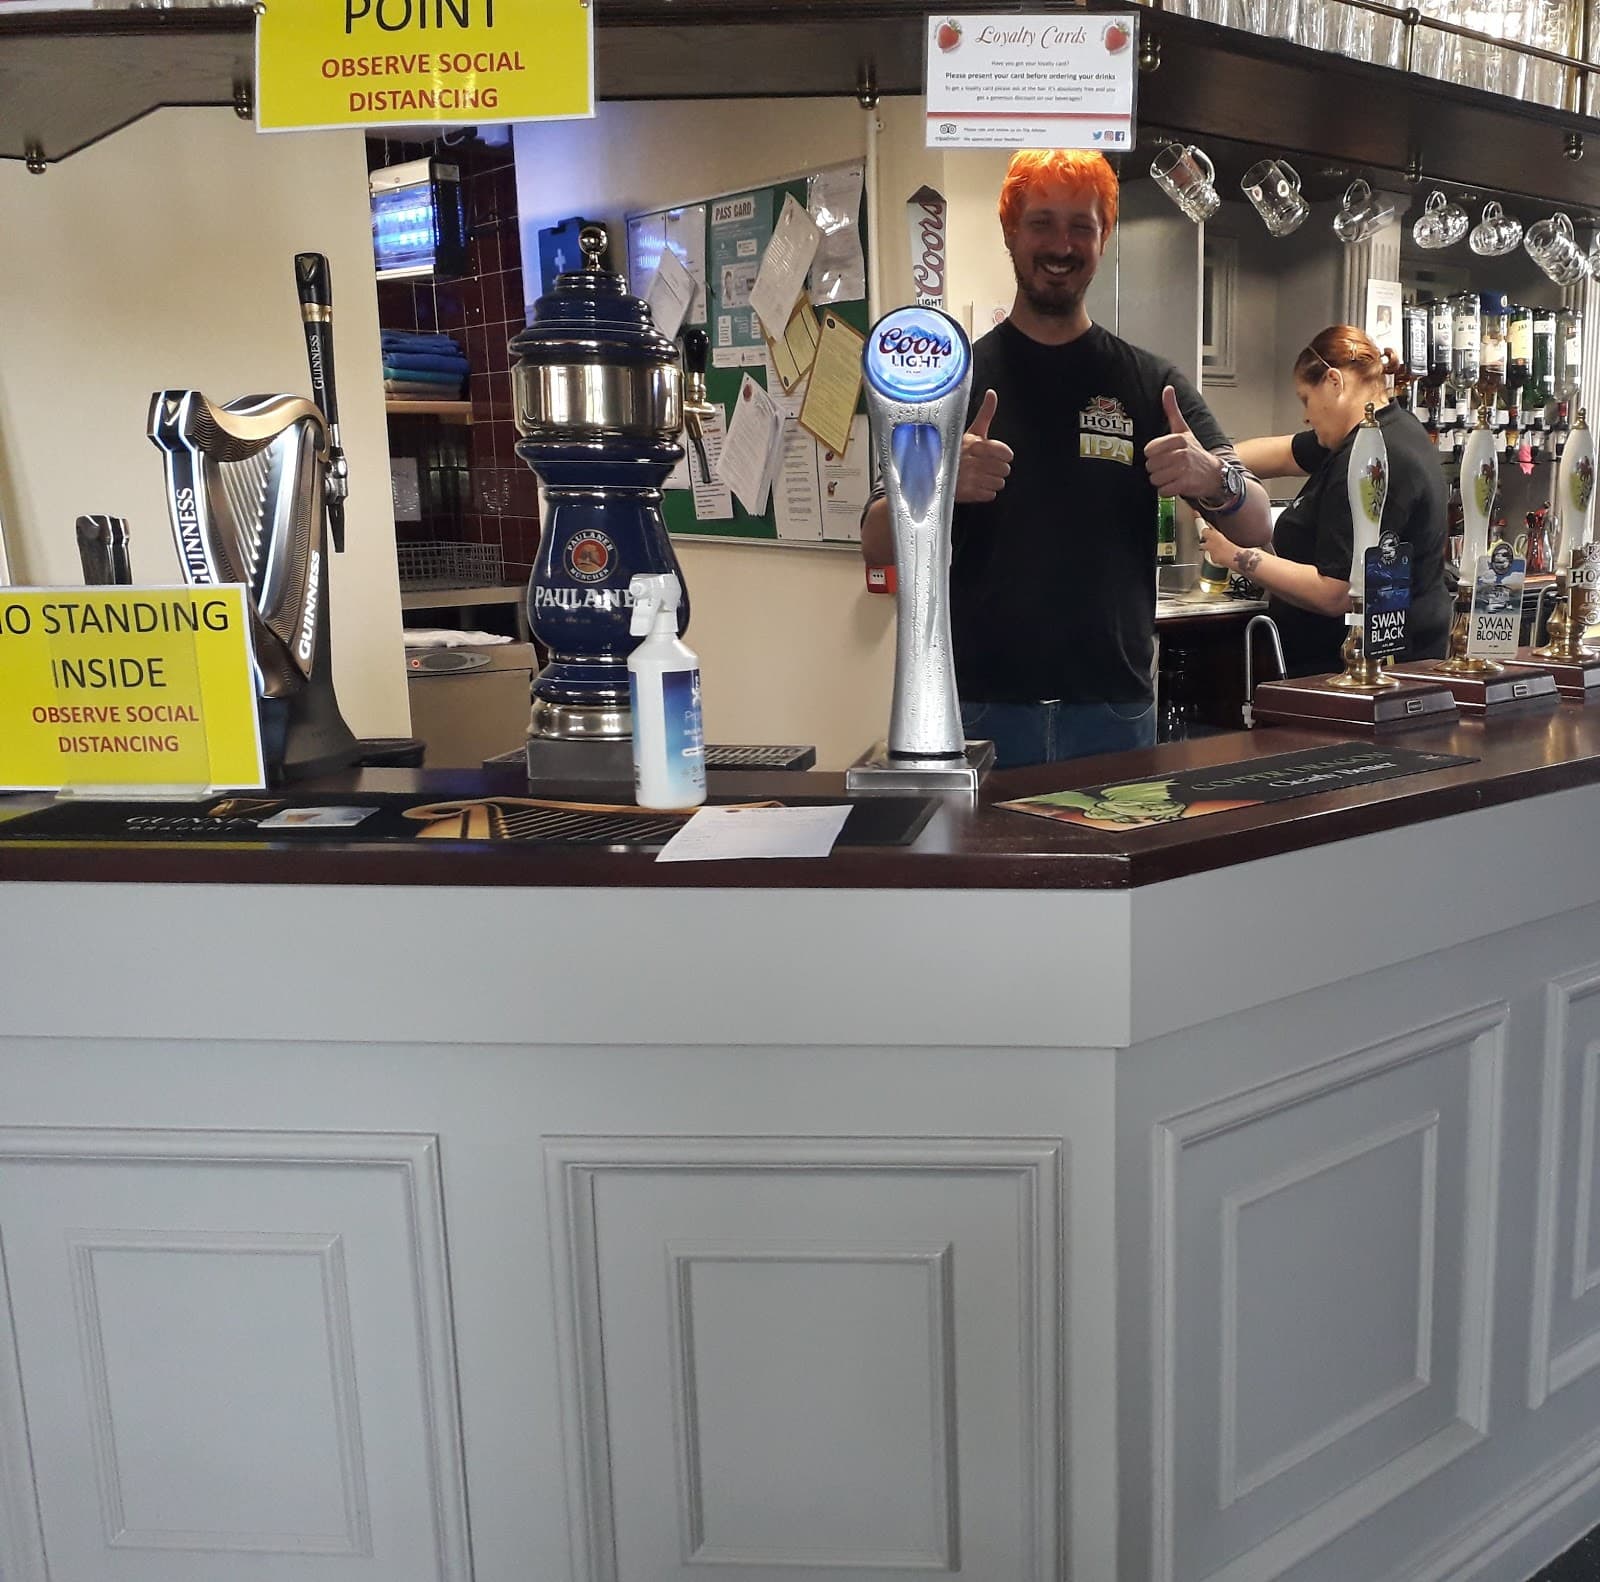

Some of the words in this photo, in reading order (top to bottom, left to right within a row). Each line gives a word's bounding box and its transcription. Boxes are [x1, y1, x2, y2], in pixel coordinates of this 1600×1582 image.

[344, 0, 494, 34] POINT
[974, 25, 1036, 47] Loyalty
[1040, 26, 1088, 49] Cards
[321, 53, 430, 79] OBSERVE
[438, 51, 526, 73] SOCIAL
[945, 72, 966, 80] Please
[968, 72, 992, 80] present
[1010, 72, 1025, 80] card
[1026, 72, 1048, 80] before
[1049, 73, 1077, 81] ordering
[349, 87, 498, 113] DISTANCING
[715, 205, 732, 221] PASS
[733, 201, 752, 217] CARD
[913, 200, 945, 297] Coors
[917, 298, 943, 307] LIGHT
[879, 327, 953, 355] Coors
[309, 334, 325, 390] GUINNESS
[892, 354, 942, 369] LIGHT
[1083, 415, 1131, 432] HOLT
[1084, 435, 1131, 461] IPA
[567, 531, 613, 552] PAULANER
[298, 550, 321, 660] GUINNESS
[535, 585, 637, 611] PAULANE
[42, 600, 229, 634] STANDING
[1371, 610, 1405, 630] SWAN
[1477, 616, 1514, 630] SWAN
[1371, 626, 1404, 644] BLACK
[1476, 629, 1513, 641] BLONDE
[51, 658, 167, 689] INSIDE
[32, 706, 121, 723] OBSERVE
[127, 705, 199, 722] SOCIAL
[58, 735, 179, 753] DISTANCING
[1288, 751, 1393, 773] DRAGON
